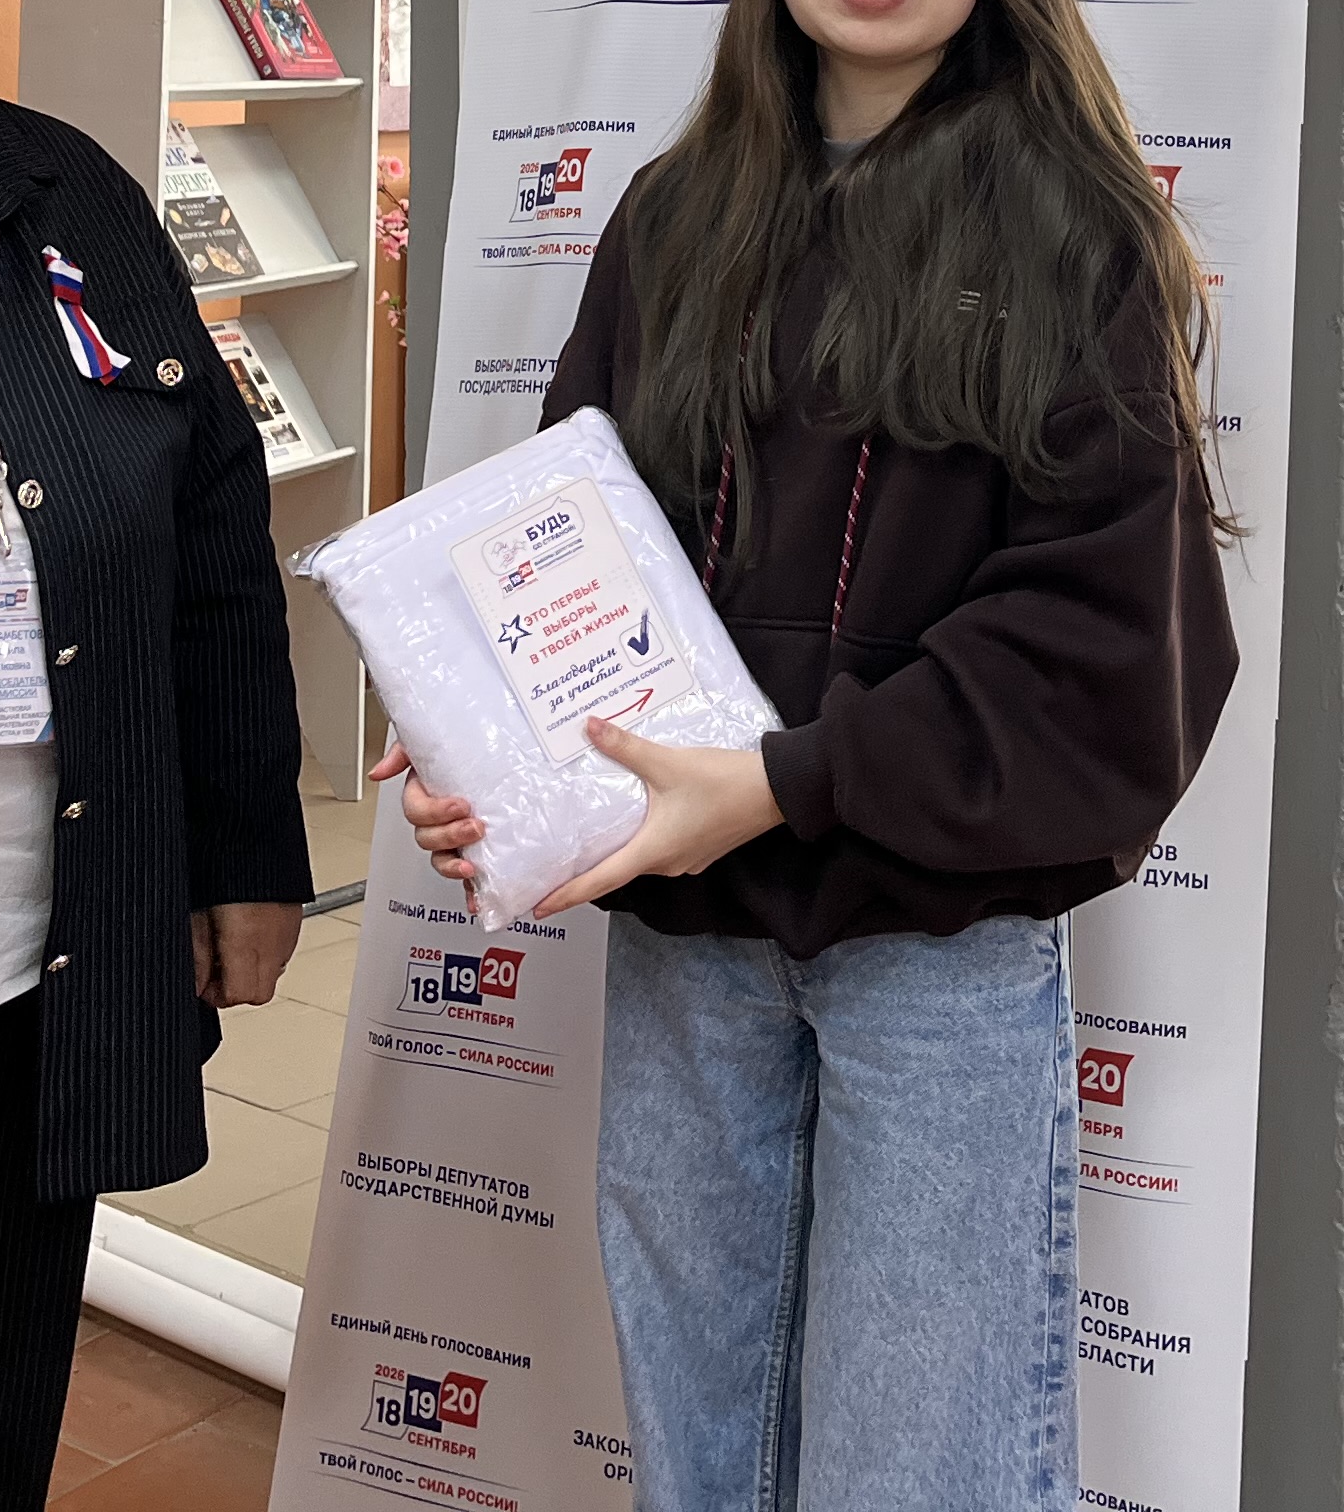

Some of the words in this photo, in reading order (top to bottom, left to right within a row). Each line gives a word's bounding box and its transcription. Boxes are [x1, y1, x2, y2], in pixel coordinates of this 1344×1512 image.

[492, 125, 533, 141] ЕДИНЫЙ
[533, 125, 556, 139] ДЕНЬ
[557, 120, 635, 135] ГОЛОСОВАНИЯ
[1135, 134, 1232, 149] ОСОВАНИЯ
[519, 162, 540, 174] 2026
[164, 172, 214, 194] ОЧЕМУ?
[519, 189, 535, 213] 18
[540, 172, 555, 198] 19
[557, 157, 583, 184] 20
[537, 207, 582, 221] СЕНТЯБРЯ
[481, 245, 506, 259] ТВОЙ
[507, 245, 532, 258] ГОЛОС
[538, 243, 561, 255] СИЛА
[564, 243, 598, 255] РОС
[474, 359, 513, 373] ВЫБОРЫ
[514, 358, 558, 373] ДЕПУТ
[459, 380, 553, 395] ГОСУДАРСТВЕНН
[525, 512, 571, 542] БУДЬ
[524, 607, 549, 626] ЭТО
[550, 579, 601, 613] ПЕРВЫЕ
[542, 601, 598, 637] ВЫБОРЫ
[529, 653, 540, 664] В
[540, 629, 582, 658] ТВОЕЙ
[582, 604, 630, 636] ЖИЗНИ
[530, 647, 618, 700] Благодарим
[549, 696, 565, 714] за
[1143, 868, 1208, 890] ДУМЫ
[388, 899, 426, 920] ЕДИНЫЙ
[428, 910, 466, 925] ДЕНЬ
[409, 946, 442, 961] 2026
[411, 977, 440, 1004] 18
[447, 966, 476, 994] 19
[482, 958, 516, 988] 20
[447, 1006, 515, 1029] СЕНТЯБРЯ
[1075, 1011, 1187, 1039] ОЛОСОВАНИЯ
[368, 1031, 393, 1049] ТВОЙ
[396, 1039, 444, 1056] ГОЛОС
[459, 1048, 494, 1066] СИЛА
[496, 1055, 555, 1077] РОССИИ!
[1081, 1059, 1122, 1094] 20
[357, 1151, 432, 1179] ВЫБОРЫ
[436, 1166, 530, 1200] ДЕПУТАТОВ
[1104, 1168, 1179, 1193] РОССИИ!
[340, 1169, 498, 1218] ГОСУДАРСТВЕННОЙ
[501, 1204, 555, 1229] ДУМЫ
[331, 1313, 391, 1336] ЕДИНЫЙ
[393, 1326, 428, 1346] ДЕНЬ
[431, 1334, 531, 1370] ГОЛОСОВАНИЯ
[1081, 1316, 1191, 1354] СОБРАНИЯ
[1078, 1341, 1154, 1376] БЛАСТИ
[374, 1364, 405, 1382] 2026
[376, 1396, 401, 1427] 18
[409, 1389, 436, 1419] 19
[442, 1383, 478, 1416] 20
[407, 1432, 476, 1460] СЕНТЯБРЯ
[573, 1430, 632, 1458] ЗАКОН
[319, 1452, 357, 1471] ТВОЙ
[359, 1461, 403, 1483] ГОЛОС
[418, 1476, 454, 1497] СИЛА
